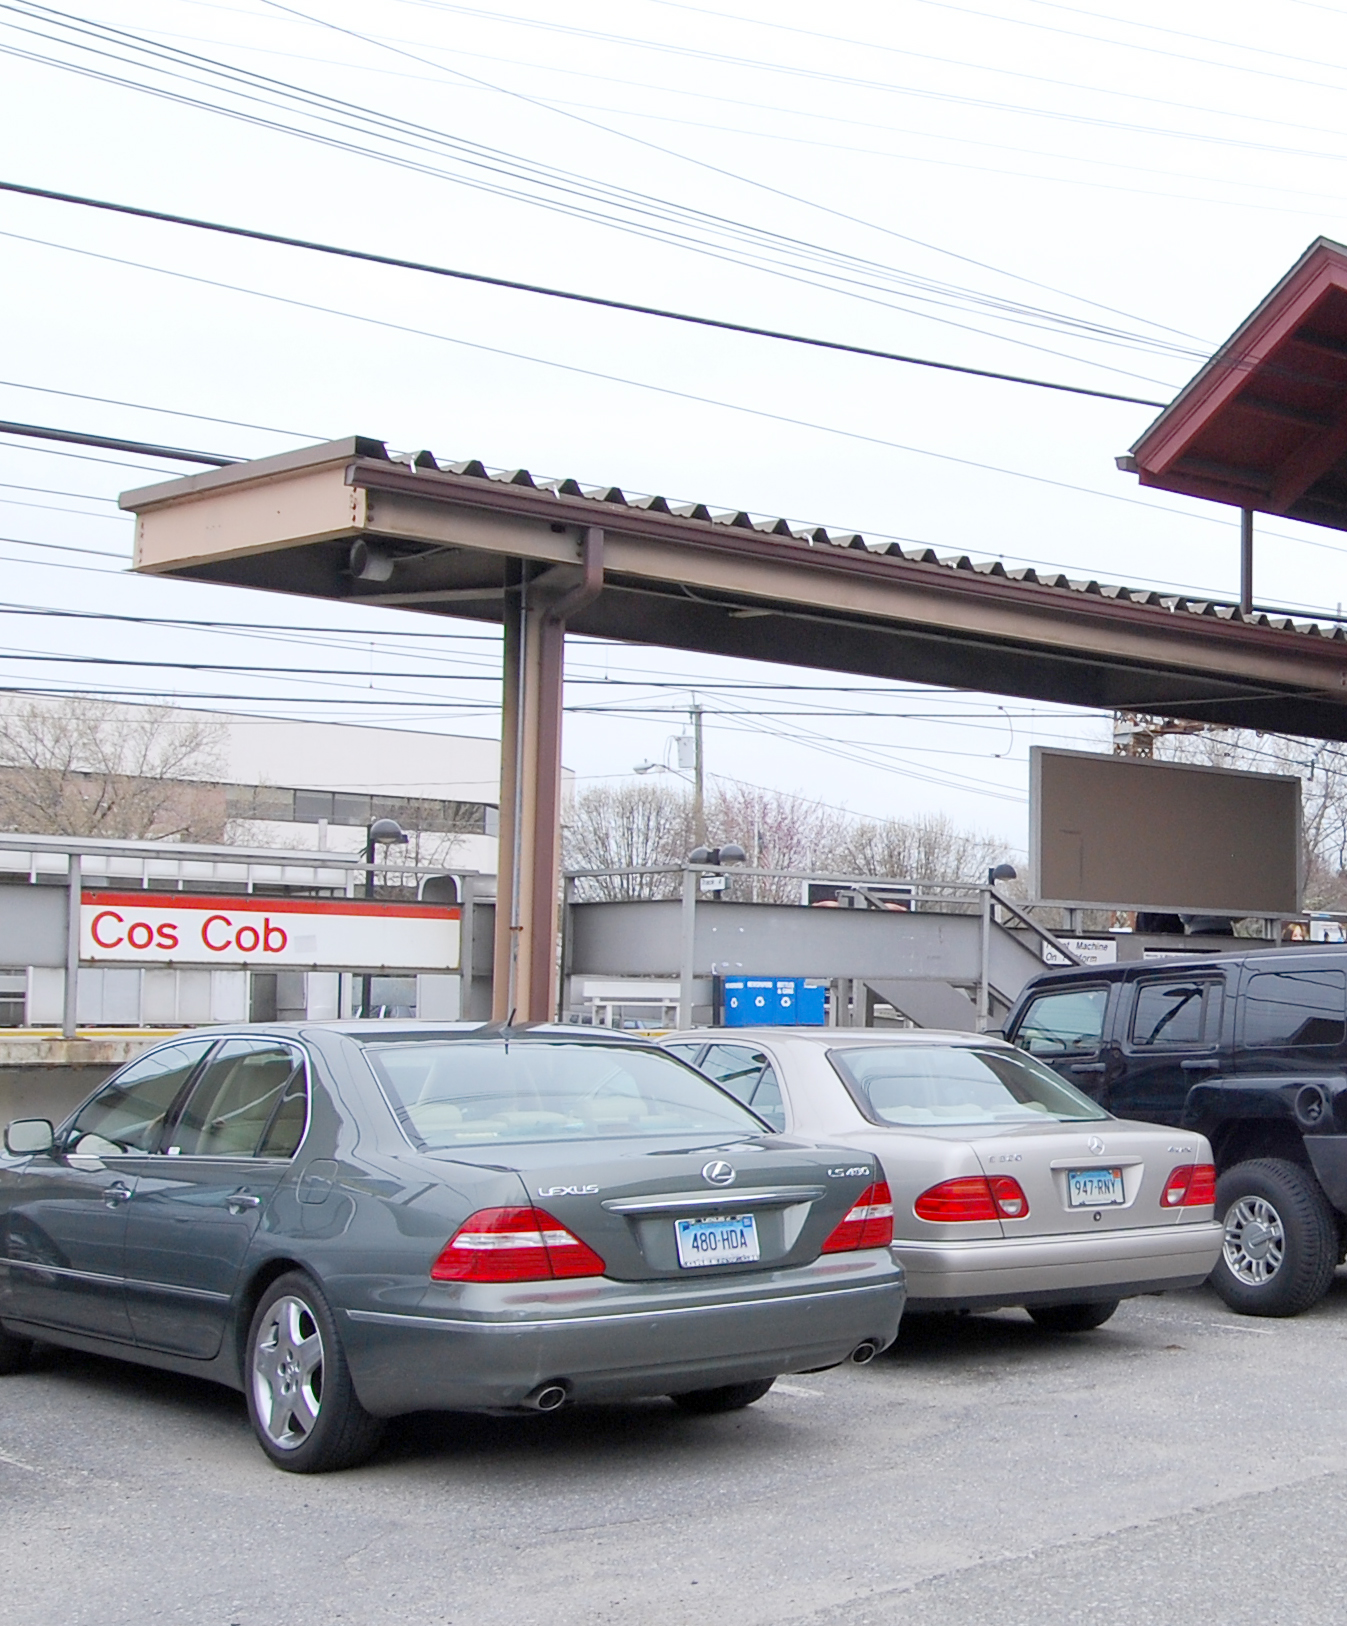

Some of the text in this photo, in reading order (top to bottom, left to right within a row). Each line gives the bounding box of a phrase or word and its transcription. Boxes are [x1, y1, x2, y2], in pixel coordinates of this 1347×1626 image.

[91, 910, 288, 953] Cos Cob
[1076, 941, 1108, 951] Machine
[1046, 952, 1058, 961] On
[538, 1184, 600, 1197] LEXUS
